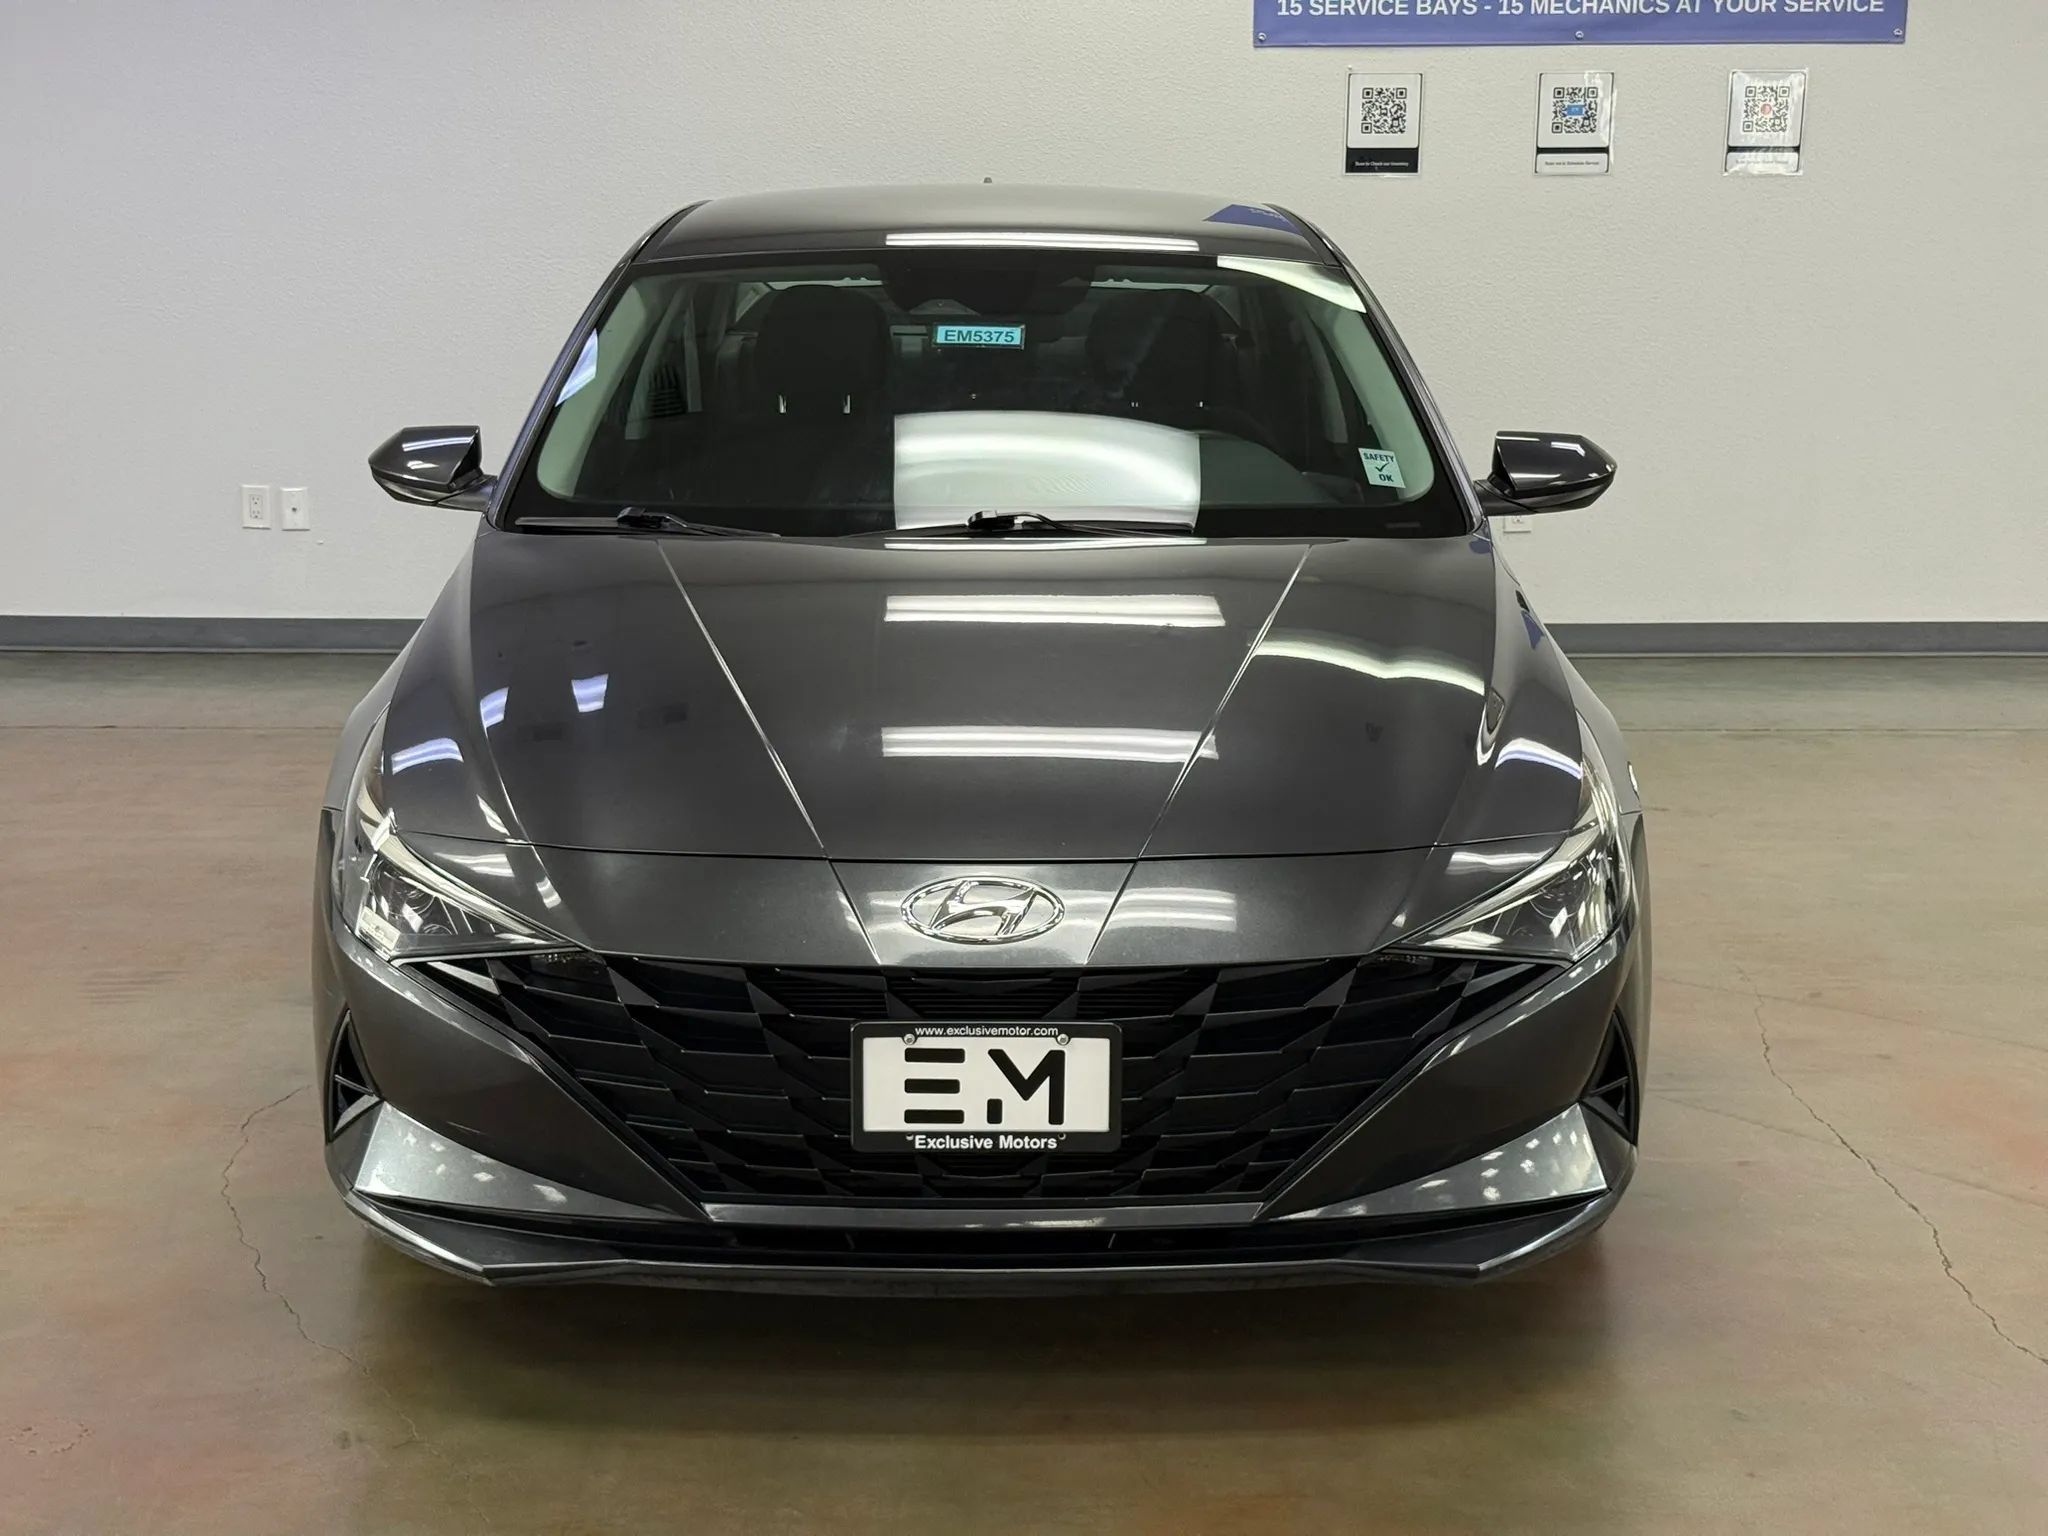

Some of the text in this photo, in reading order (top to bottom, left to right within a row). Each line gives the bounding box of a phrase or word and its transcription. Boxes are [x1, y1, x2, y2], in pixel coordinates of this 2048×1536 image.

[1277, 0, 1303, 16] 15
[1308, 0, 1410, 16] SERVICE
[1415, 0, 1478, 16] BAYS
[1498, 0, 1524, 15] 15
[1530, 0, 1670, 15] MECHANICS
[1712, 0, 1777, 14] YOUR
[1783, 0, 1885, 13] SERVICE
[944, 329, 1015, 343] EM5375
[1363, 452, 1394, 463] SAFETY
[1378, 473, 1395, 483] OK
[914, 1025, 1059, 1037] www.exclusivemotor.com
[914, 1134, 1058, 1150] Exclusive Motors
